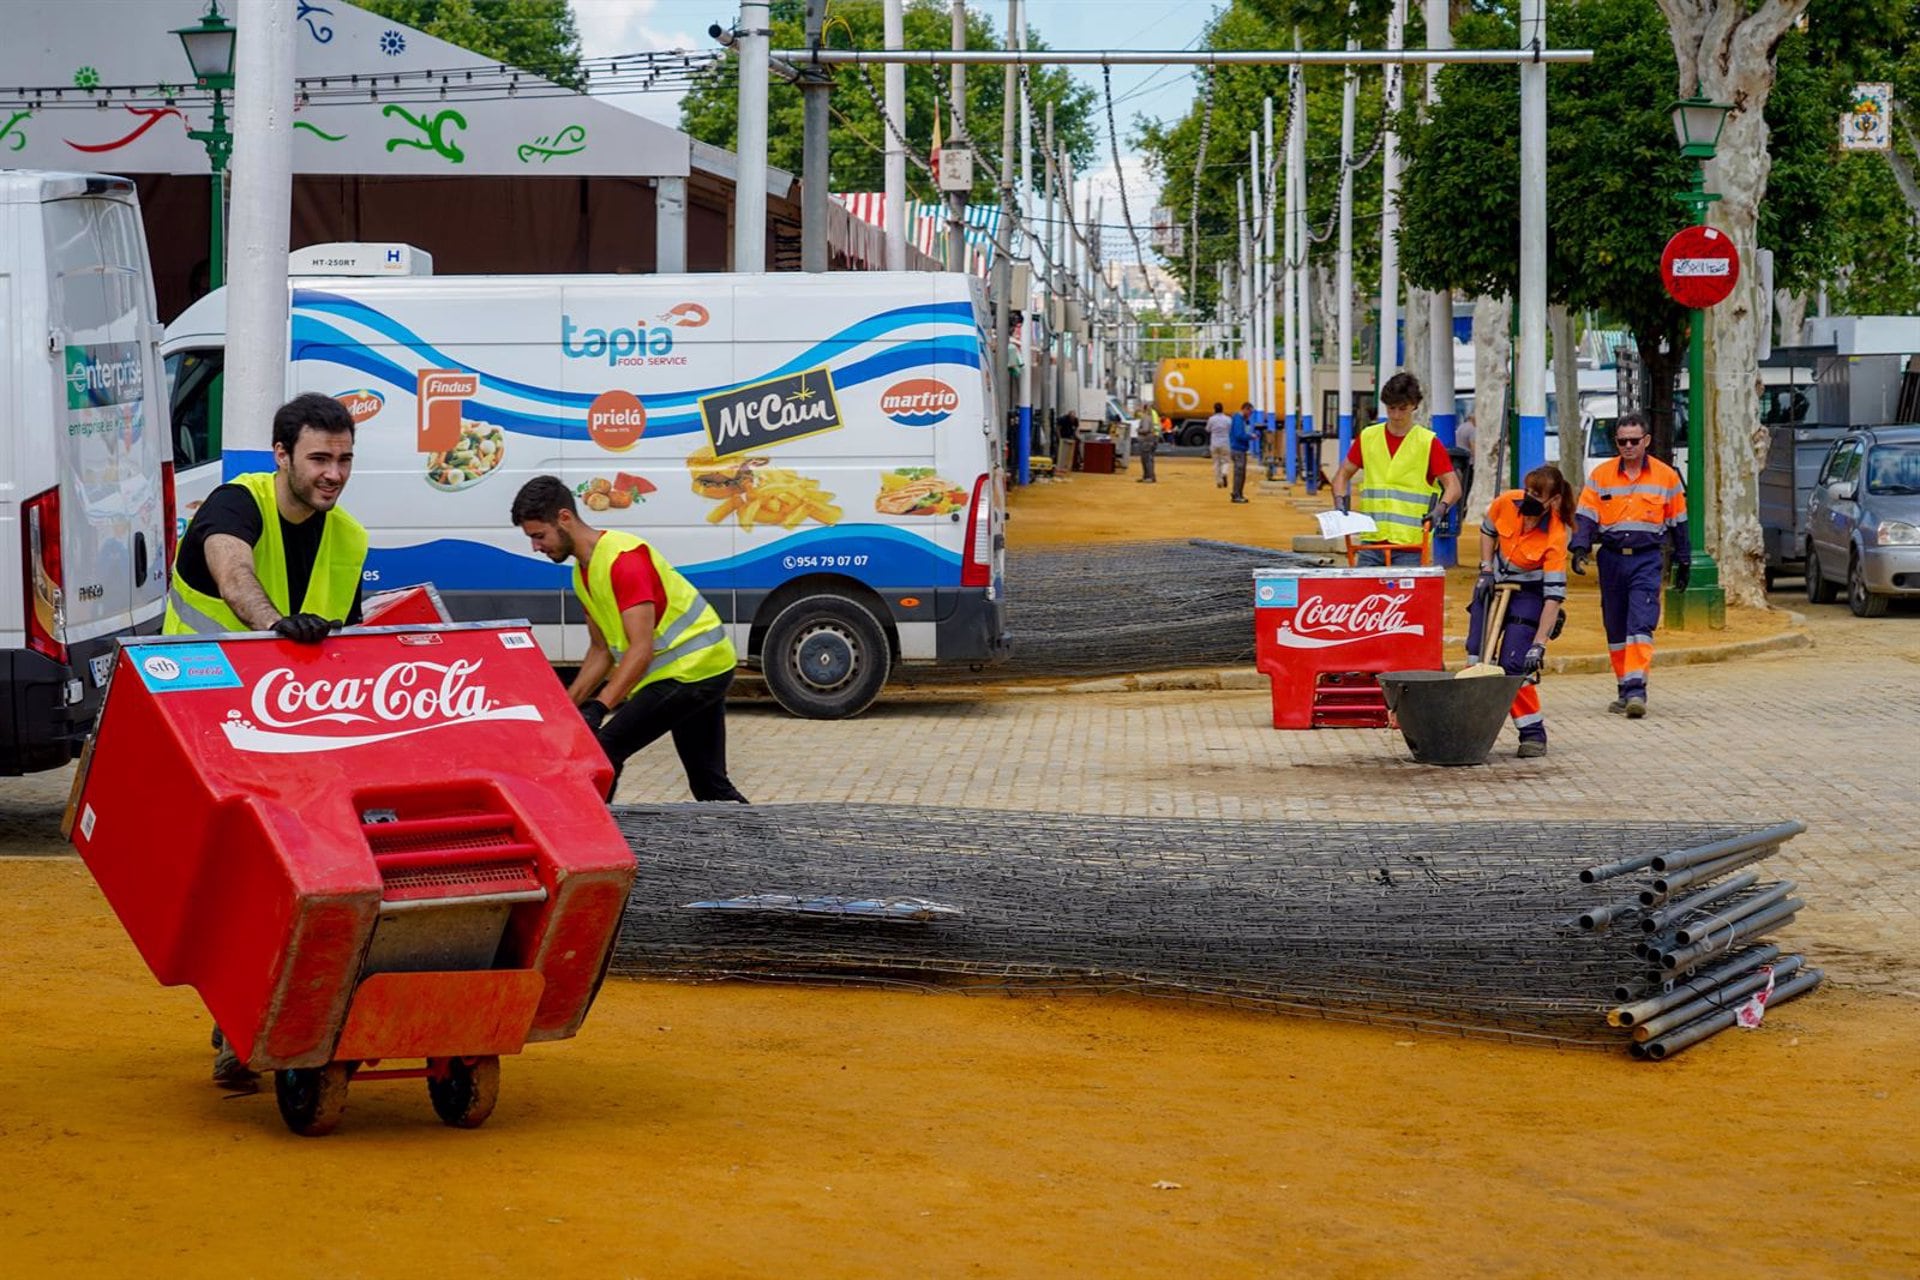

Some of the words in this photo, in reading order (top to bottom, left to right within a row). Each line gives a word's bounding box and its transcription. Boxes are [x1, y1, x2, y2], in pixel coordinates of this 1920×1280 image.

[561, 314, 673, 367] tapia
[66, 351, 142, 393] enterprise
[618, 358, 644, 366] FOOD
[648, 357, 687, 366] SERVICE
[430, 381, 472, 393] Findus
[347, 397, 379, 416] desa
[882, 389, 956, 409] marfrío
[592, 409, 641, 431] prielá
[715, 394, 837, 447] McCain
[797, 556, 817, 567] 954
[821, 556, 835, 566] 79
[837, 556, 851, 566] 07
[854, 555, 868, 566] 07
[1294, 594, 1413, 633] Coca-Cola
[252, 657, 496, 728] Coca-Cola
